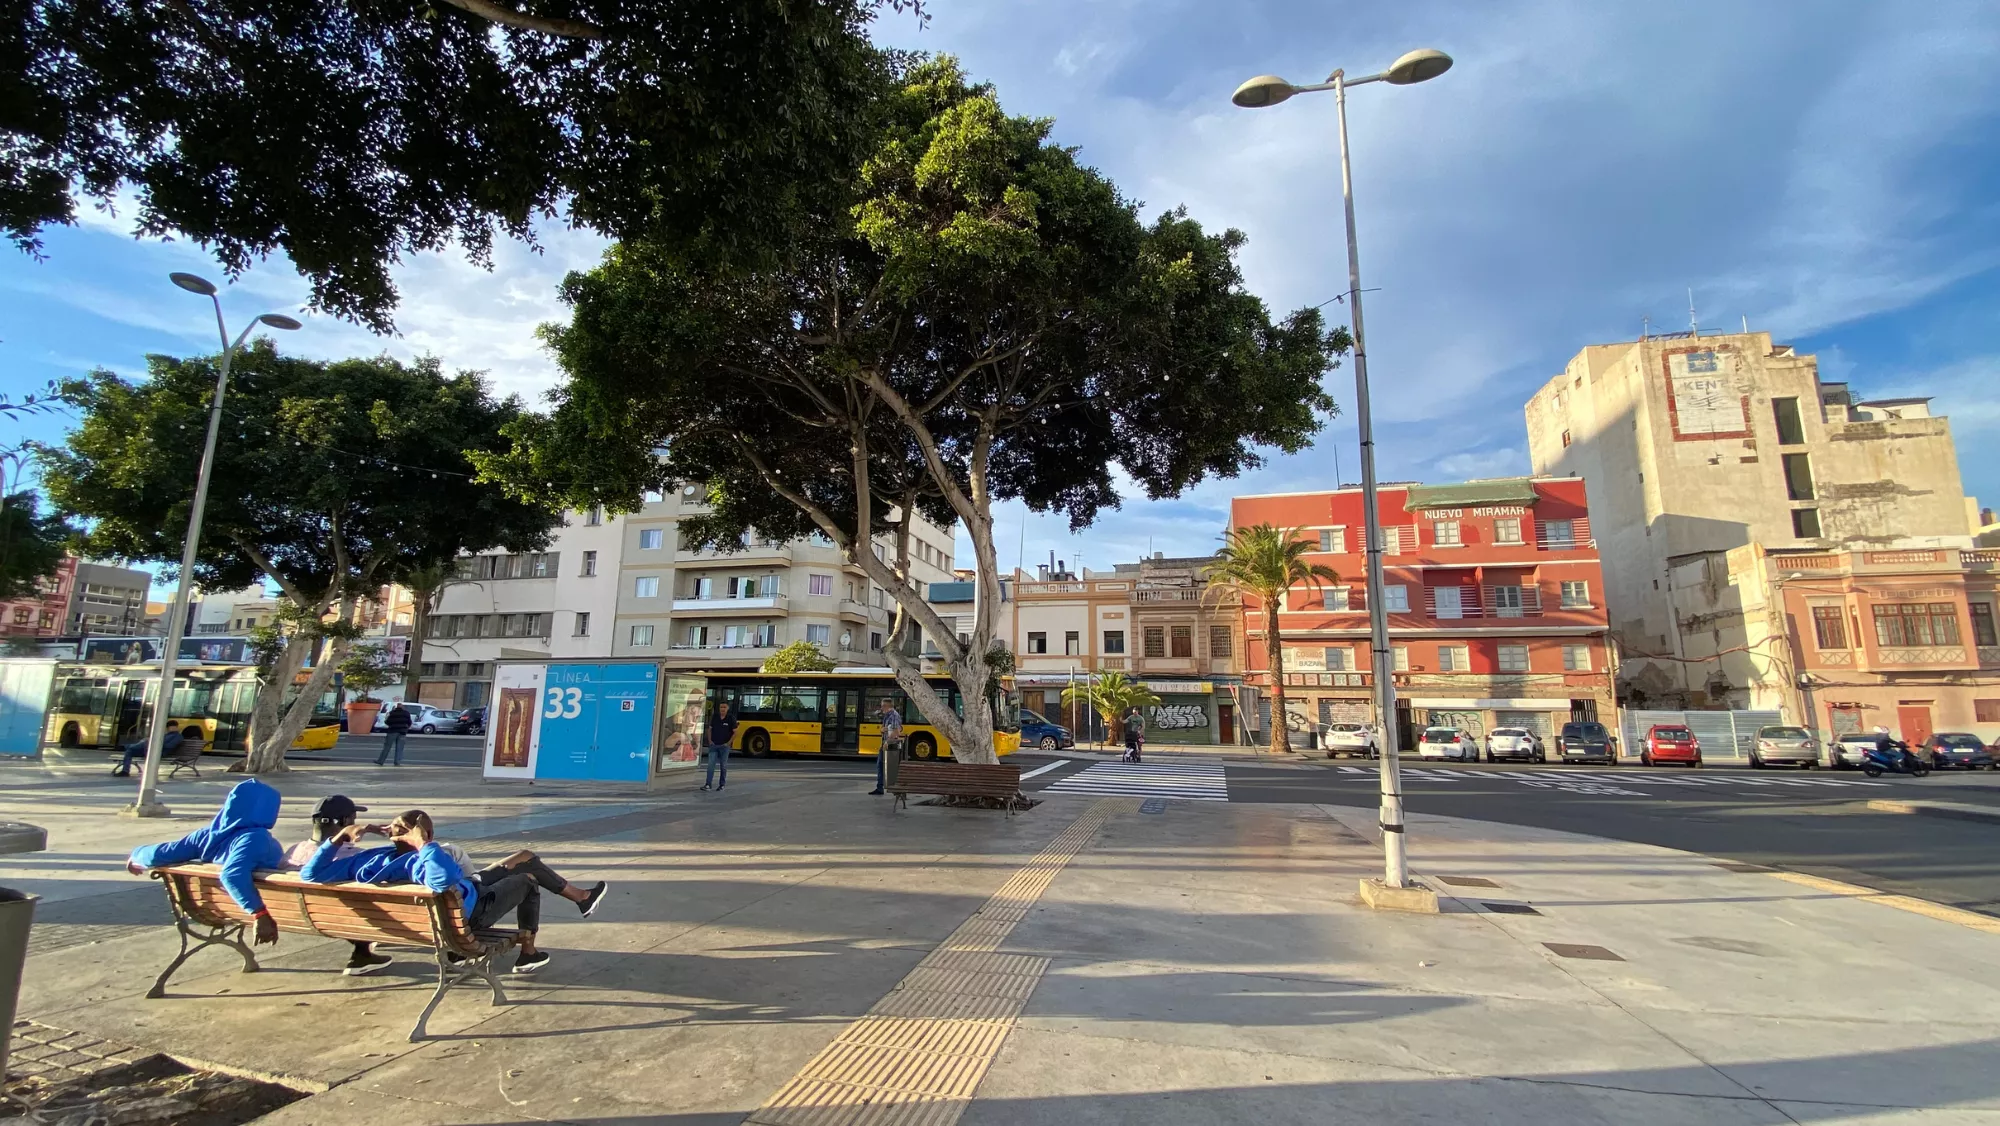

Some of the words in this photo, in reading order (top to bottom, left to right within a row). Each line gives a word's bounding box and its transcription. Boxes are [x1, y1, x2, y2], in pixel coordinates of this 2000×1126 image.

[1424, 508, 1463, 519] NUEVO
[1472, 506, 1526, 517] MIRAMAR
[556, 668, 590, 684] LÍNEA
[544, 687, 583, 719] 33
